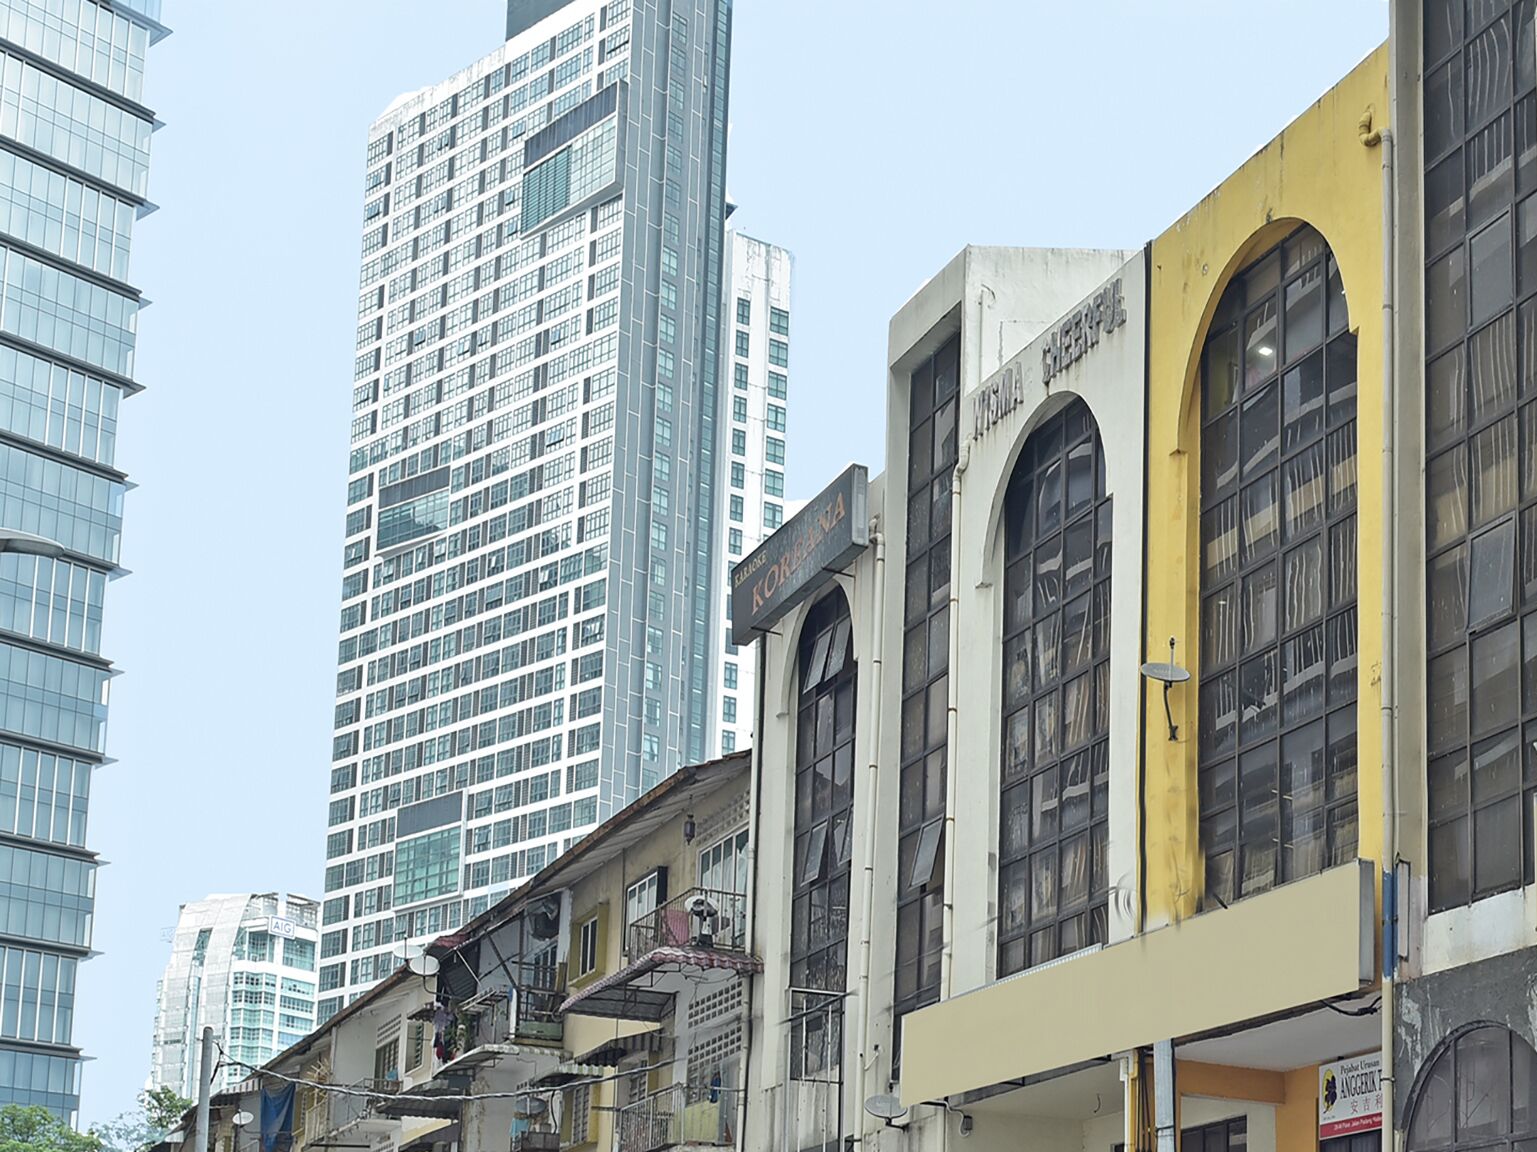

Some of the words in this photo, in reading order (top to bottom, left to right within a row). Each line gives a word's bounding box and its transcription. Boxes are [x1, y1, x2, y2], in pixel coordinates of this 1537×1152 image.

[973, 361, 1024, 441] WISMA
[1042, 278, 1127, 385] CHEERFUL
[734, 550, 767, 588] KARAOKE
[752, 492, 846, 615] KOREANA
[1340, 1070, 1377, 1099] ANGGERIK
